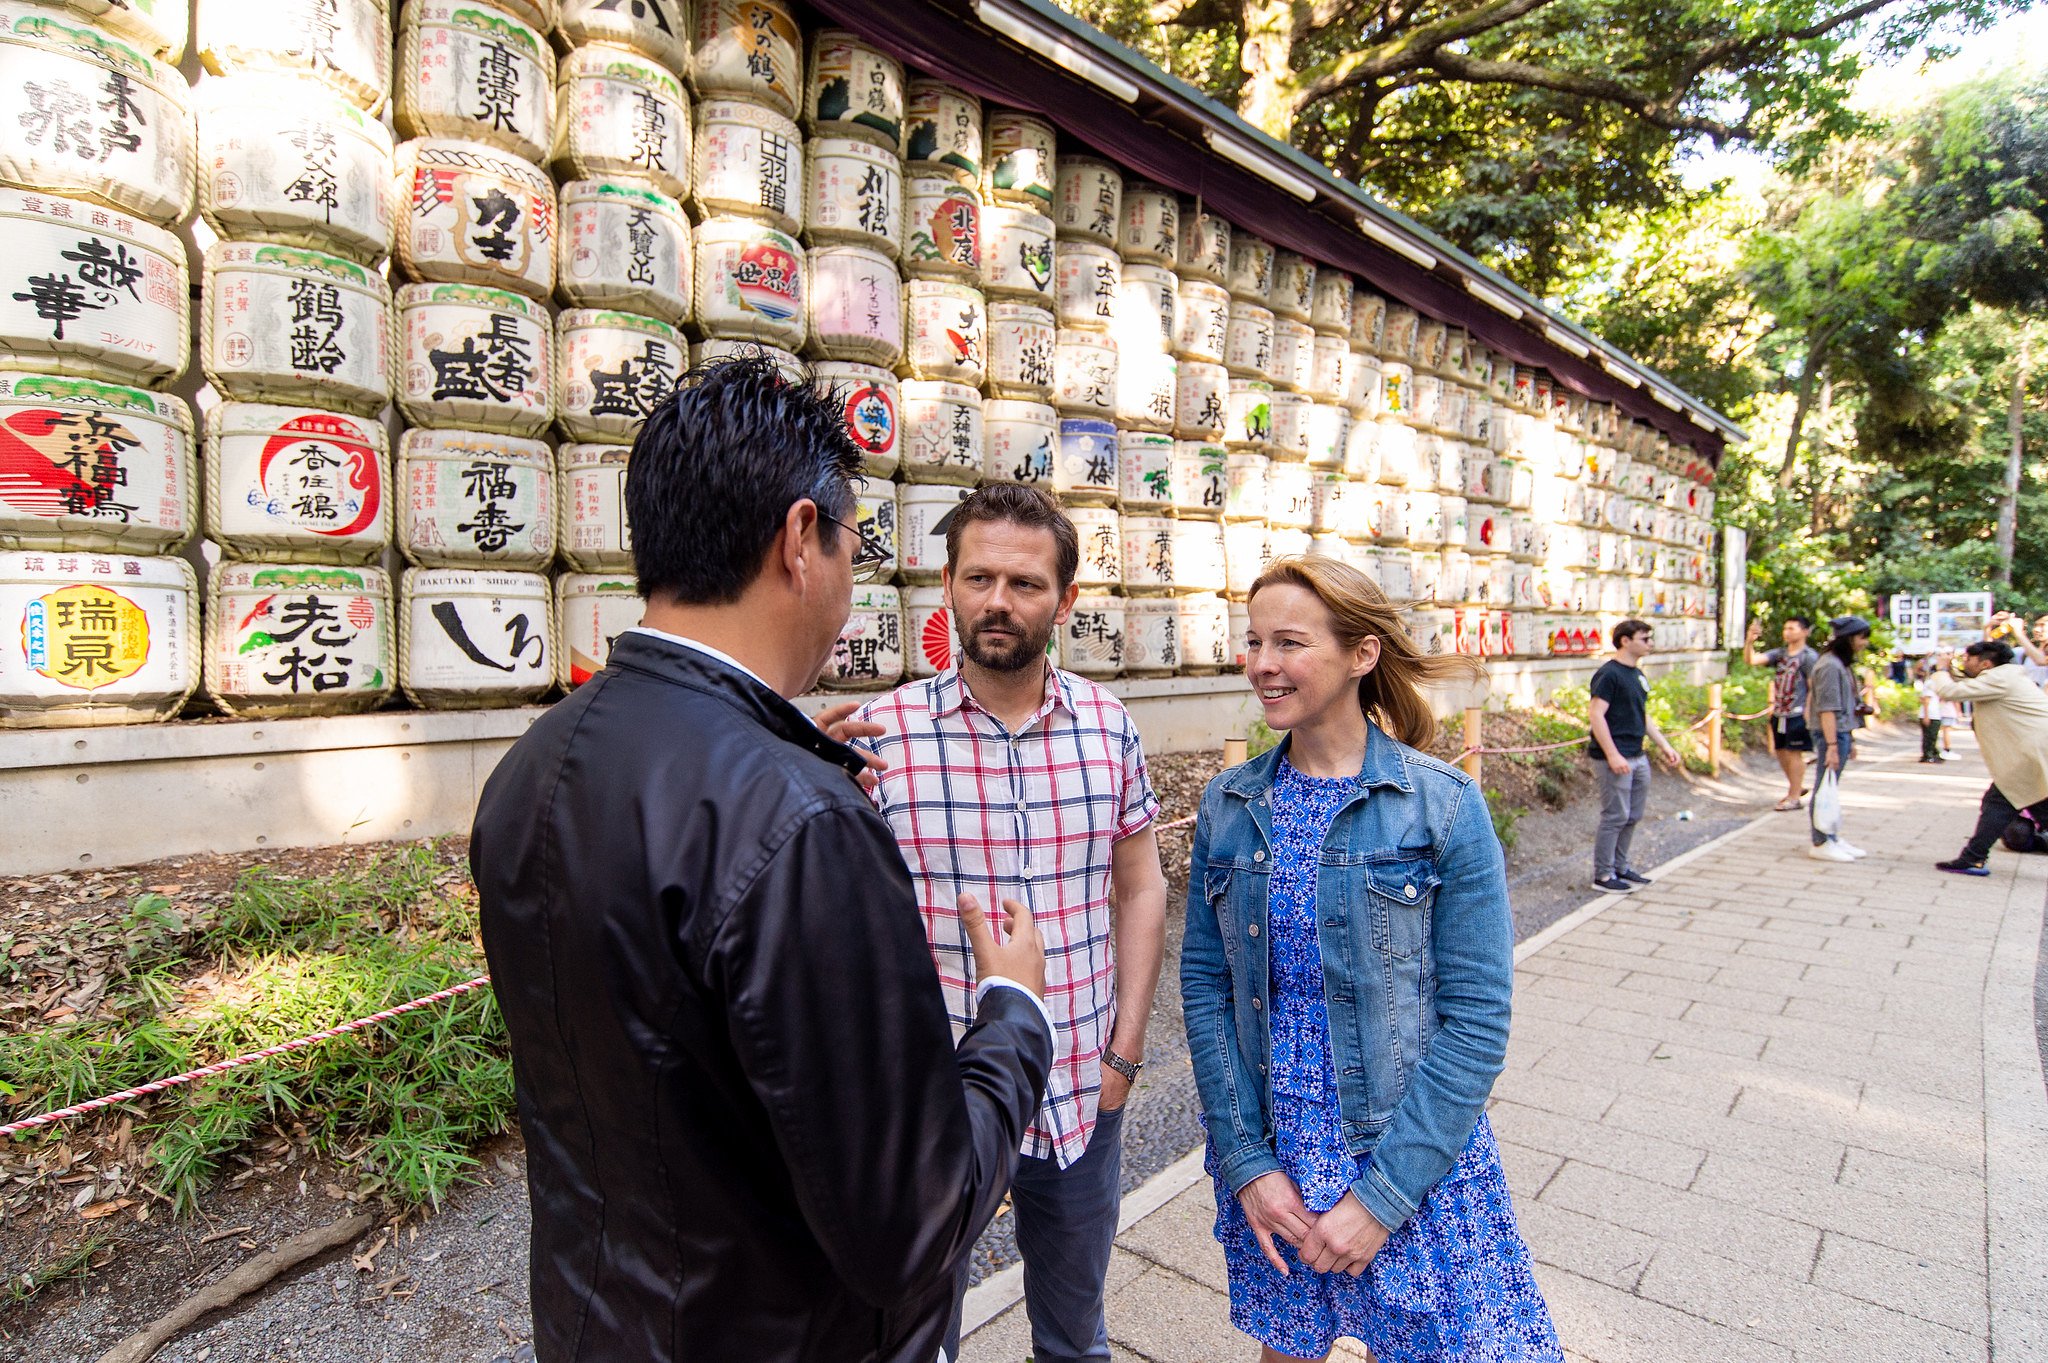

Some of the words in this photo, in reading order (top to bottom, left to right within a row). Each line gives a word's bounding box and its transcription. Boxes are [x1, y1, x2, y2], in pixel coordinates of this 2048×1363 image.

[747, 6, 778, 84] 沢の鶴
[471, 188, 521, 262] 力士
[1090, 189, 1115, 239] 白鹿
[12, 237, 144, 340] 越の華
[287, 278, 346, 374] 鶴齢
[100, 331, 156, 353] コシノハナ
[429, 314, 532, 402] 長者盛
[952, 405, 971, 465] 天神囃子
[289, 444, 341, 520] 香住鶴
[25, 557, 142, 576] 琉球泡盛
[420, 578, 475, 586] HAKUTAKE
[56, 598, 122, 677] 瑞泉
[263, 594, 358, 694] 老松
[431, 601, 544, 672] しろ
